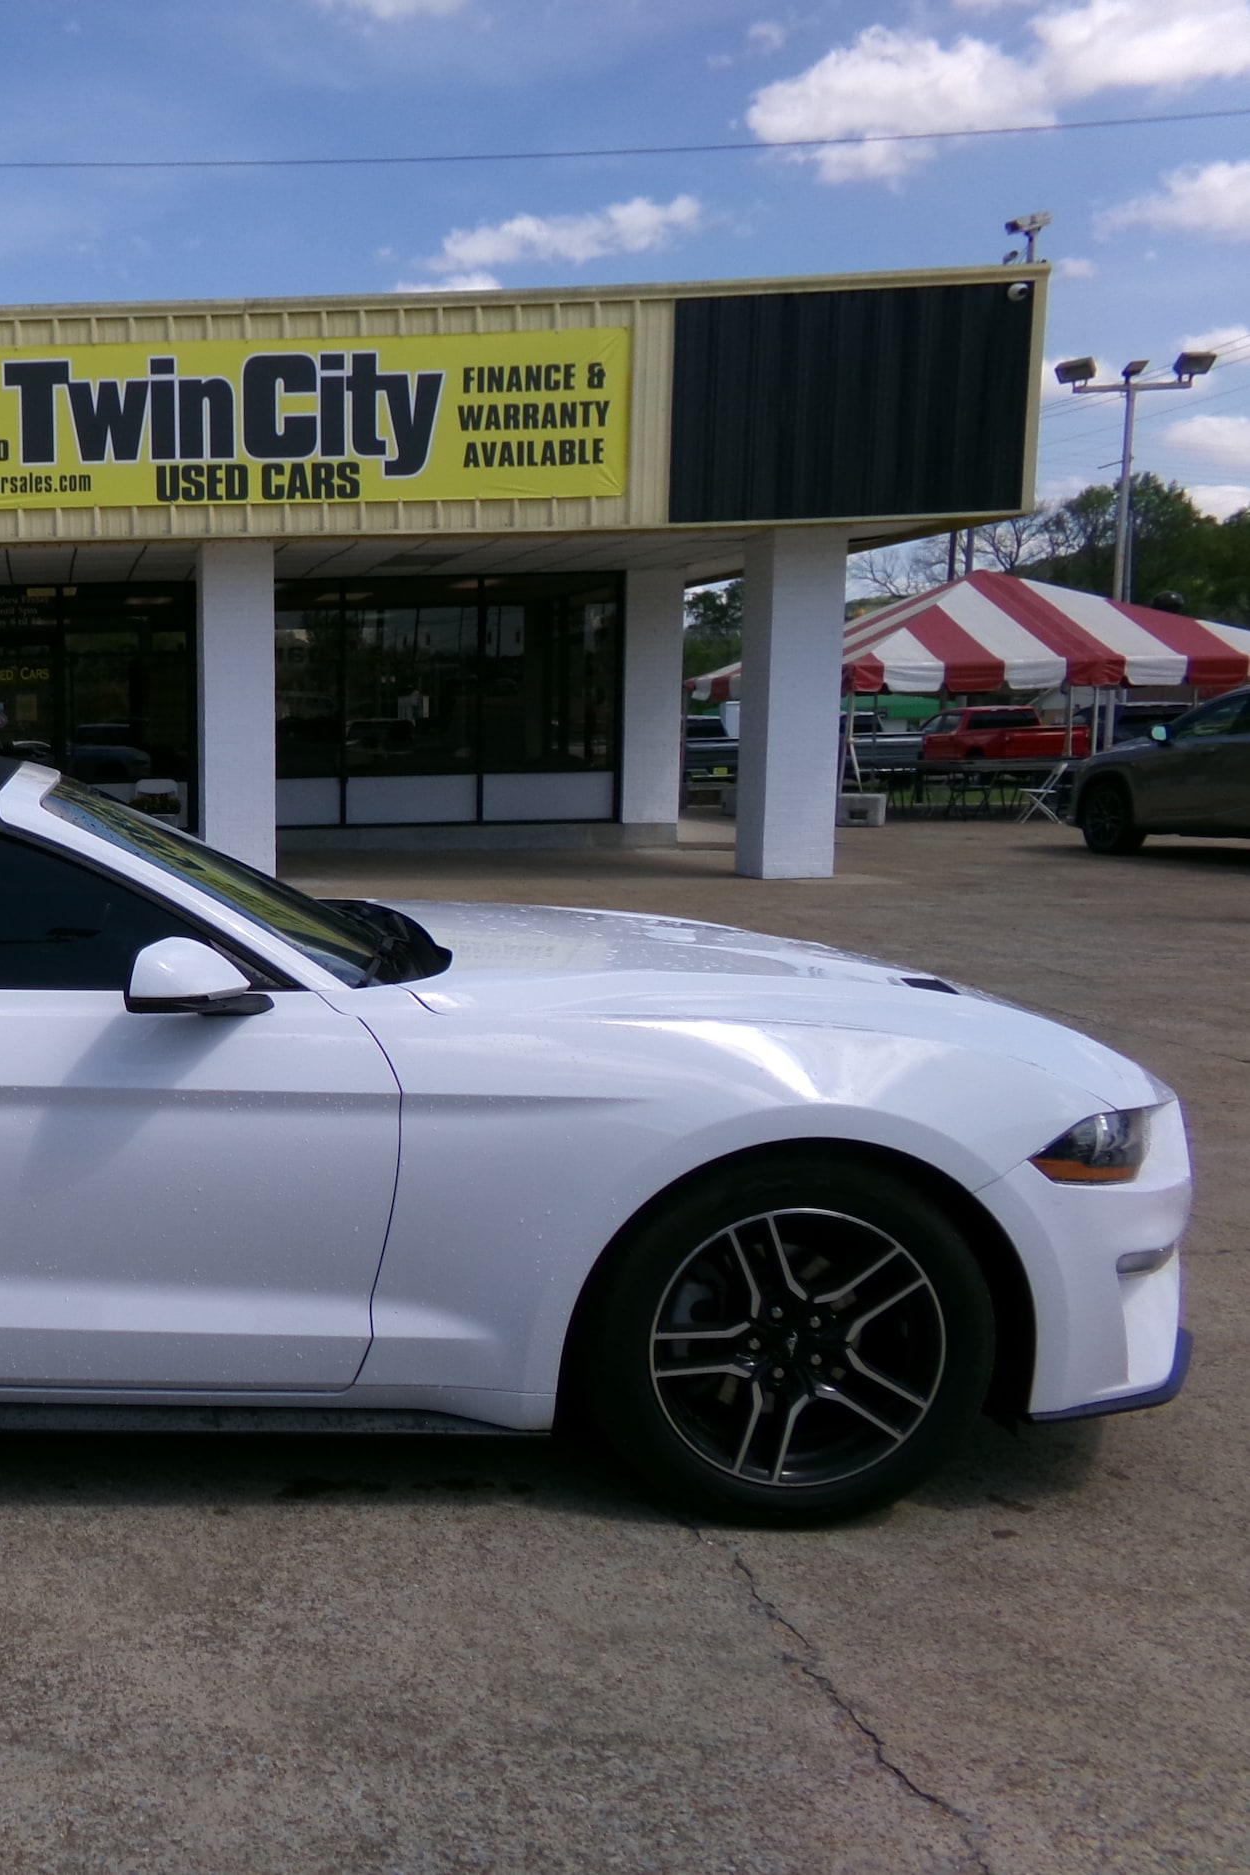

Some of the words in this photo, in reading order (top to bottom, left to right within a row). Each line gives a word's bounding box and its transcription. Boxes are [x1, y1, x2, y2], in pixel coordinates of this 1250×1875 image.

[462, 363, 576, 394] FINANCE
[587, 362, 606, 390] &
[457, 400, 611, 431] WARRANTY
[463, 438, 604, 468] AVAILABLE
[156, 464, 249, 502] USED
[261, 461, 361, 501] CARS
[20, 667, 50, 680] CARS
